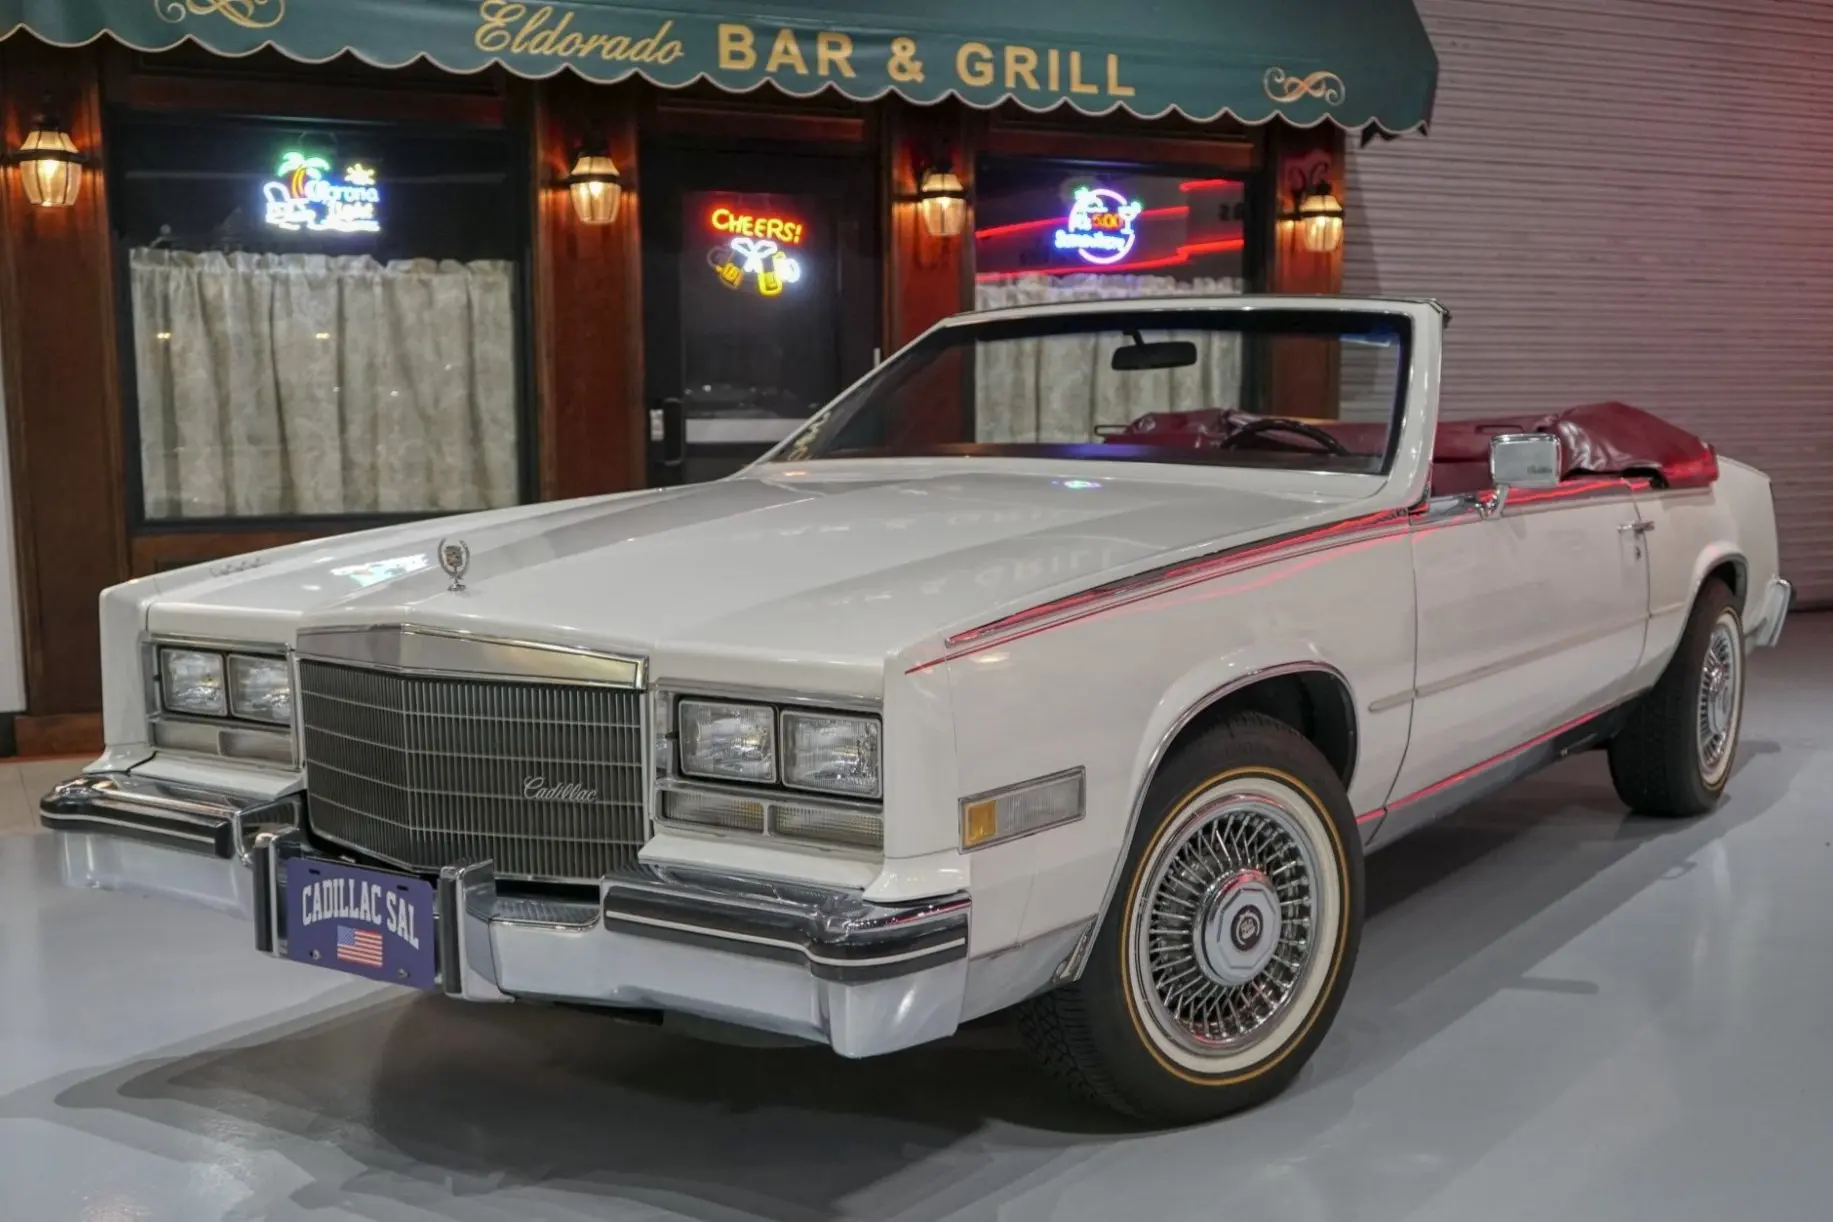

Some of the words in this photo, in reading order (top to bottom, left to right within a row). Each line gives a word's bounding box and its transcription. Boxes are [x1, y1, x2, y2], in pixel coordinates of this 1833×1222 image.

[474, 0, 684, 65] Eldorado
[717, 23, 857, 78] BAR
[887, 36, 925, 83] &
[956, 41, 1136, 97] GRILL
[711, 208, 802, 244] CHEERS!
[523, 775, 597, 802] Cadillac
[302, 878, 382, 926] CADILLAC
[386, 890, 419, 950] SAL
